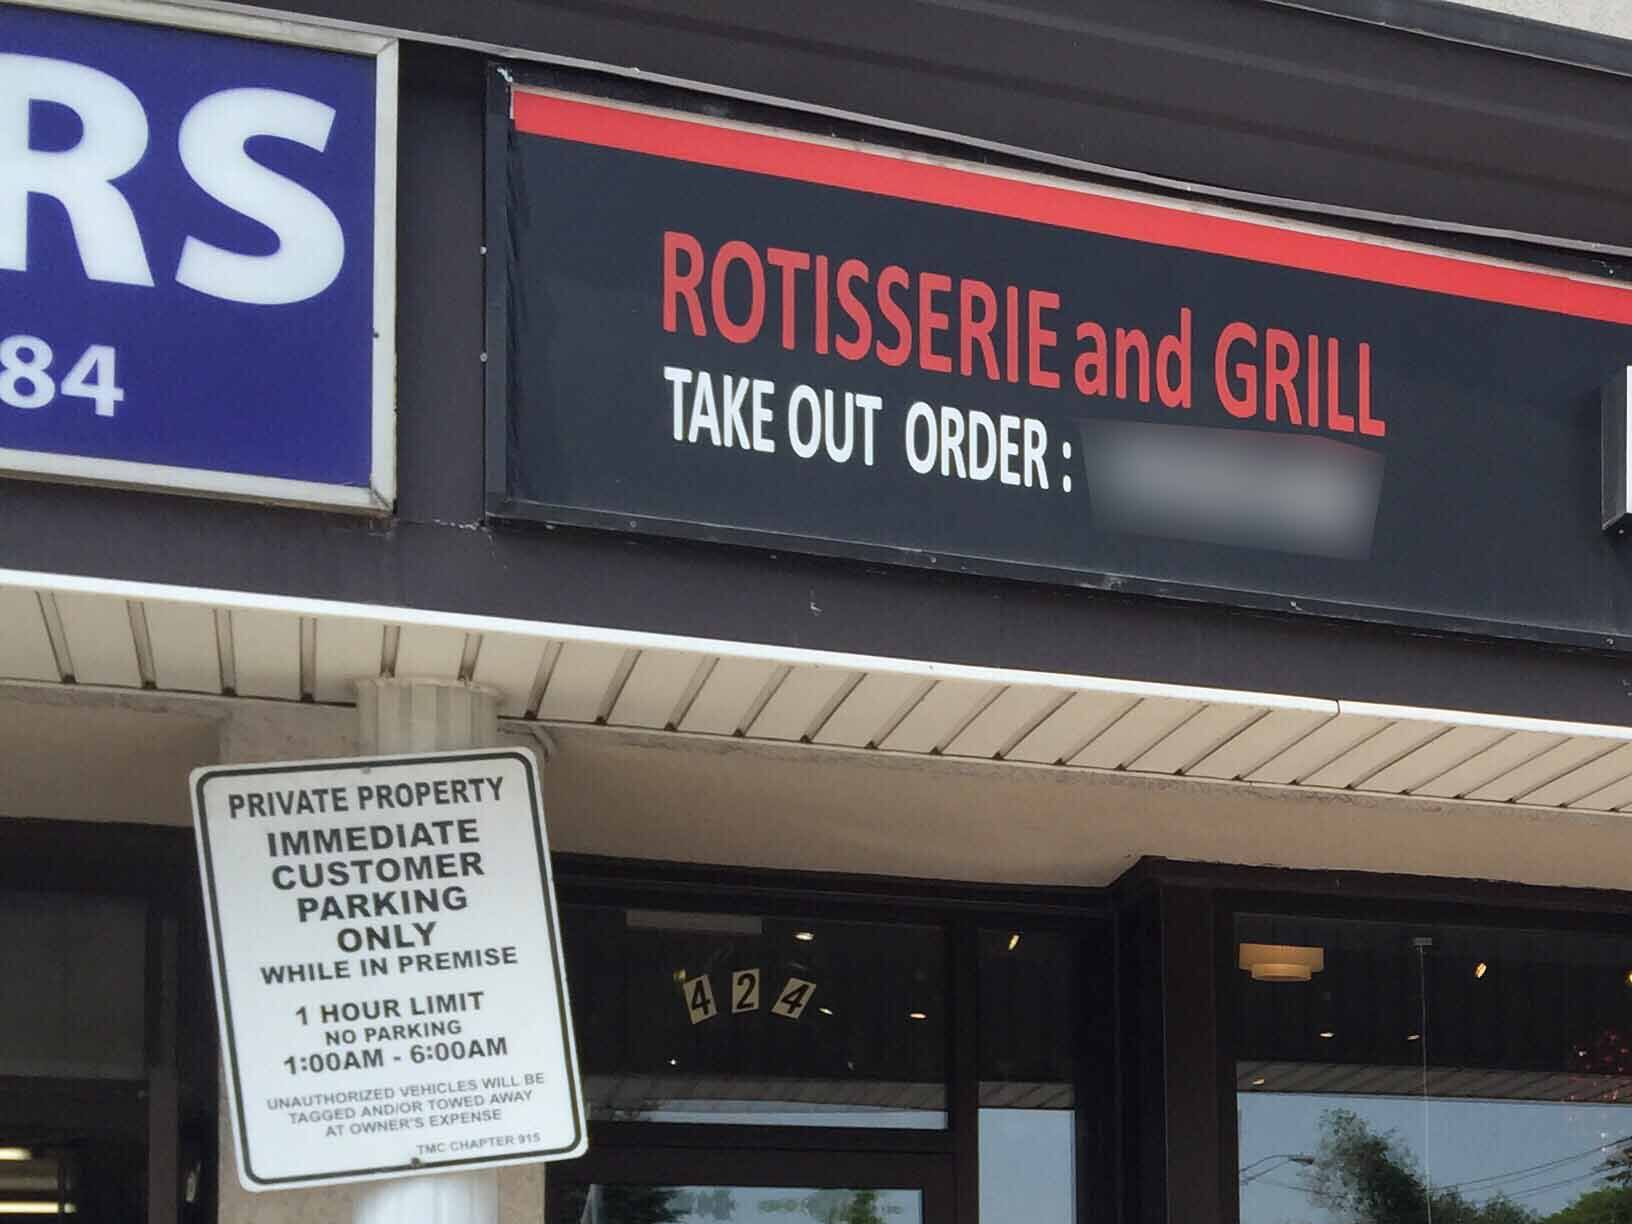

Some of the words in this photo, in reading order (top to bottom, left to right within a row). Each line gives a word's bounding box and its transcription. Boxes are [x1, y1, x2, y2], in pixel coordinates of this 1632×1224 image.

[0, 53, 345, 305] RS
[662, 231, 1062, 388] ROTISSERIE
[1075, 307, 1192, 409] and
[1214, 322, 1386, 437] GRILL
[0, 334, 124, 417] 84
[663, 366, 776, 453] TAKE
[788, 383, 883, 467] OUT
[229, 787, 349, 819] PRIVATE
[358, 776, 503, 810] PROPERTY
[267, 818, 480, 857] IMMEDIATE
[272, 852, 485, 891] CUSTOMER
[297, 886, 468, 922] PARKING
[337, 921, 436, 953] ONLY
[261, 960, 350, 985] WHILE
[361, 957, 388, 977] IN
[400, 946, 518, 974] PREMISE
[295, 1006, 309, 1025] 1
[320, 999, 401, 1024] HOUR
[410, 991, 485, 1016] LIMIT
[325, 1029, 357, 1047] NO
[365, 1019, 462, 1042] PARKING
[284, 1049, 384, 1075] 1:00AM
[410, 1037, 508, 1064] 6:00AM
[267, 1087, 395, 1111] UNAUTHORIZED
[400, 1079, 477, 1098] VEHICLES
[482, 1076, 519, 1091] WILL
[524, 1072, 545, 1085] BE
[289, 1108, 355, 1125] TAGGED
[361, 1101, 423, 1118] AND/OR
[427, 1095, 485, 1111] TOWED
[489, 1089, 533, 1105] AWAY
[325, 1124, 345, 1137] AT
[350, 1115, 424, 1135] OWNER'S
[430, 1108, 502, 1127] EXPENSE
[417, 1143, 446, 1155] TMC
[450, 1135, 515, 1152] CHAPTER
[518, 1132, 541, 1144] 915
